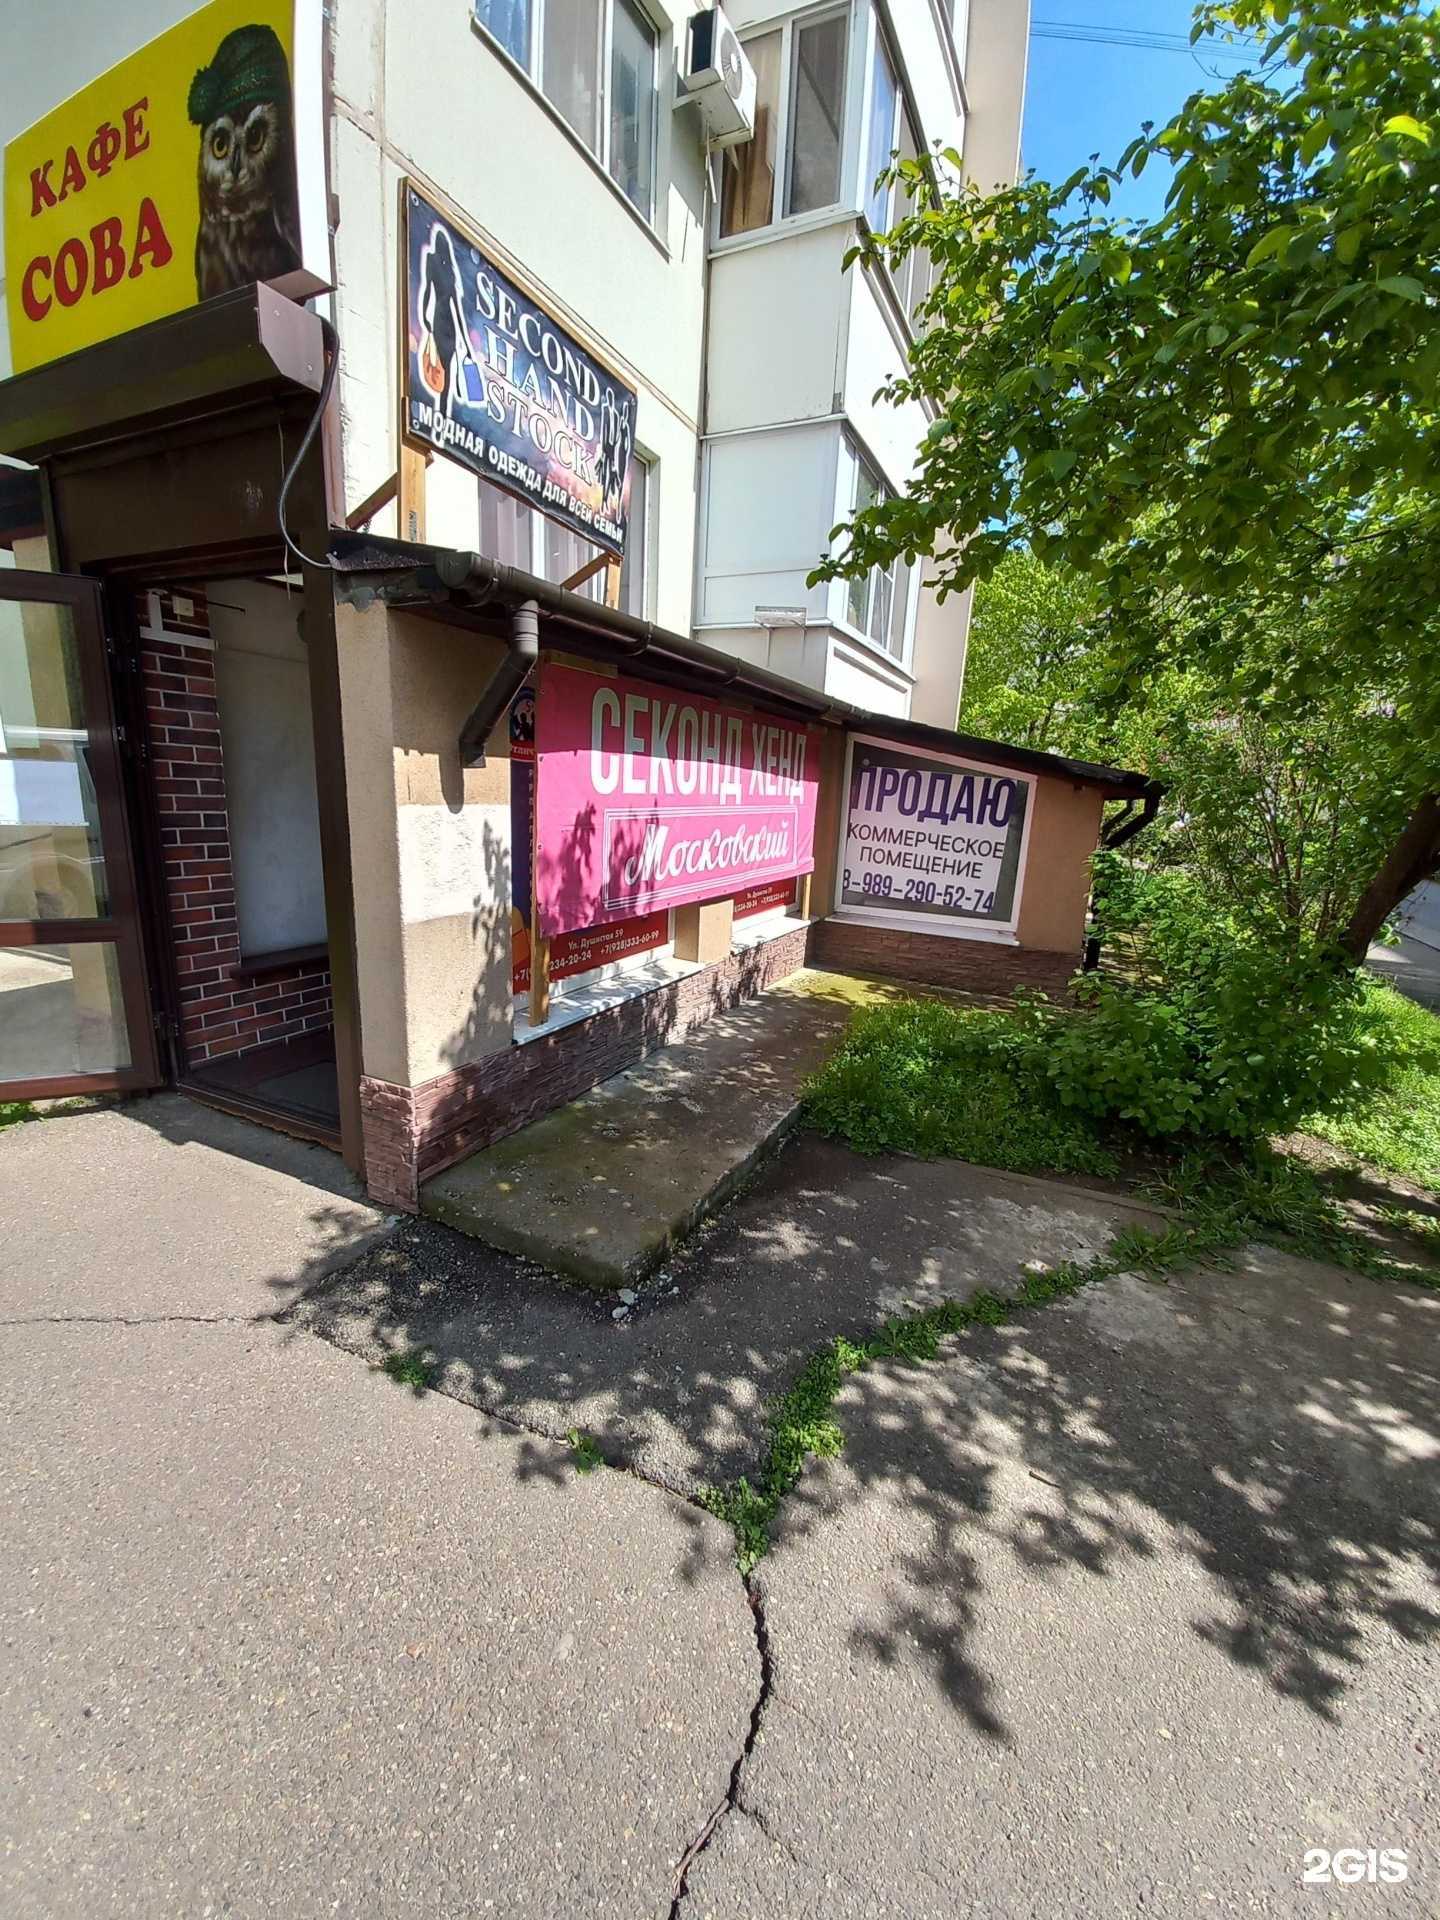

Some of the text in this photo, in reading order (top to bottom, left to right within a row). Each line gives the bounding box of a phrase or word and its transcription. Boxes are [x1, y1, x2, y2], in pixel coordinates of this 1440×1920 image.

[30, 96, 150, 218] КАФЕ
[22, 196, 173, 322] СОВА
[476, 271, 600, 407] SECOND
[484, 325, 595, 441] HAND
[419, 402, 484, 458] МОДНАЯ
[488, 445, 542, 492] ОДЕЖДА
[542, 481, 568, 507] ДЛЯ
[593, 513, 624, 544] СЕМЬИ
[487, 379, 594, 486] STOCK
[590, 687, 807, 805] СЕКОНД ХЕНД
[849, 766, 1017, 828] ПРОДАЮ
[625, 818, 791, 886] Московский
[849, 822, 1005, 860] КОММЕРЧЕСКОЕ
[859, 846, 984, 880] ПОМЕЩЕНИЕ
[615, 927, 624, 939] 59
